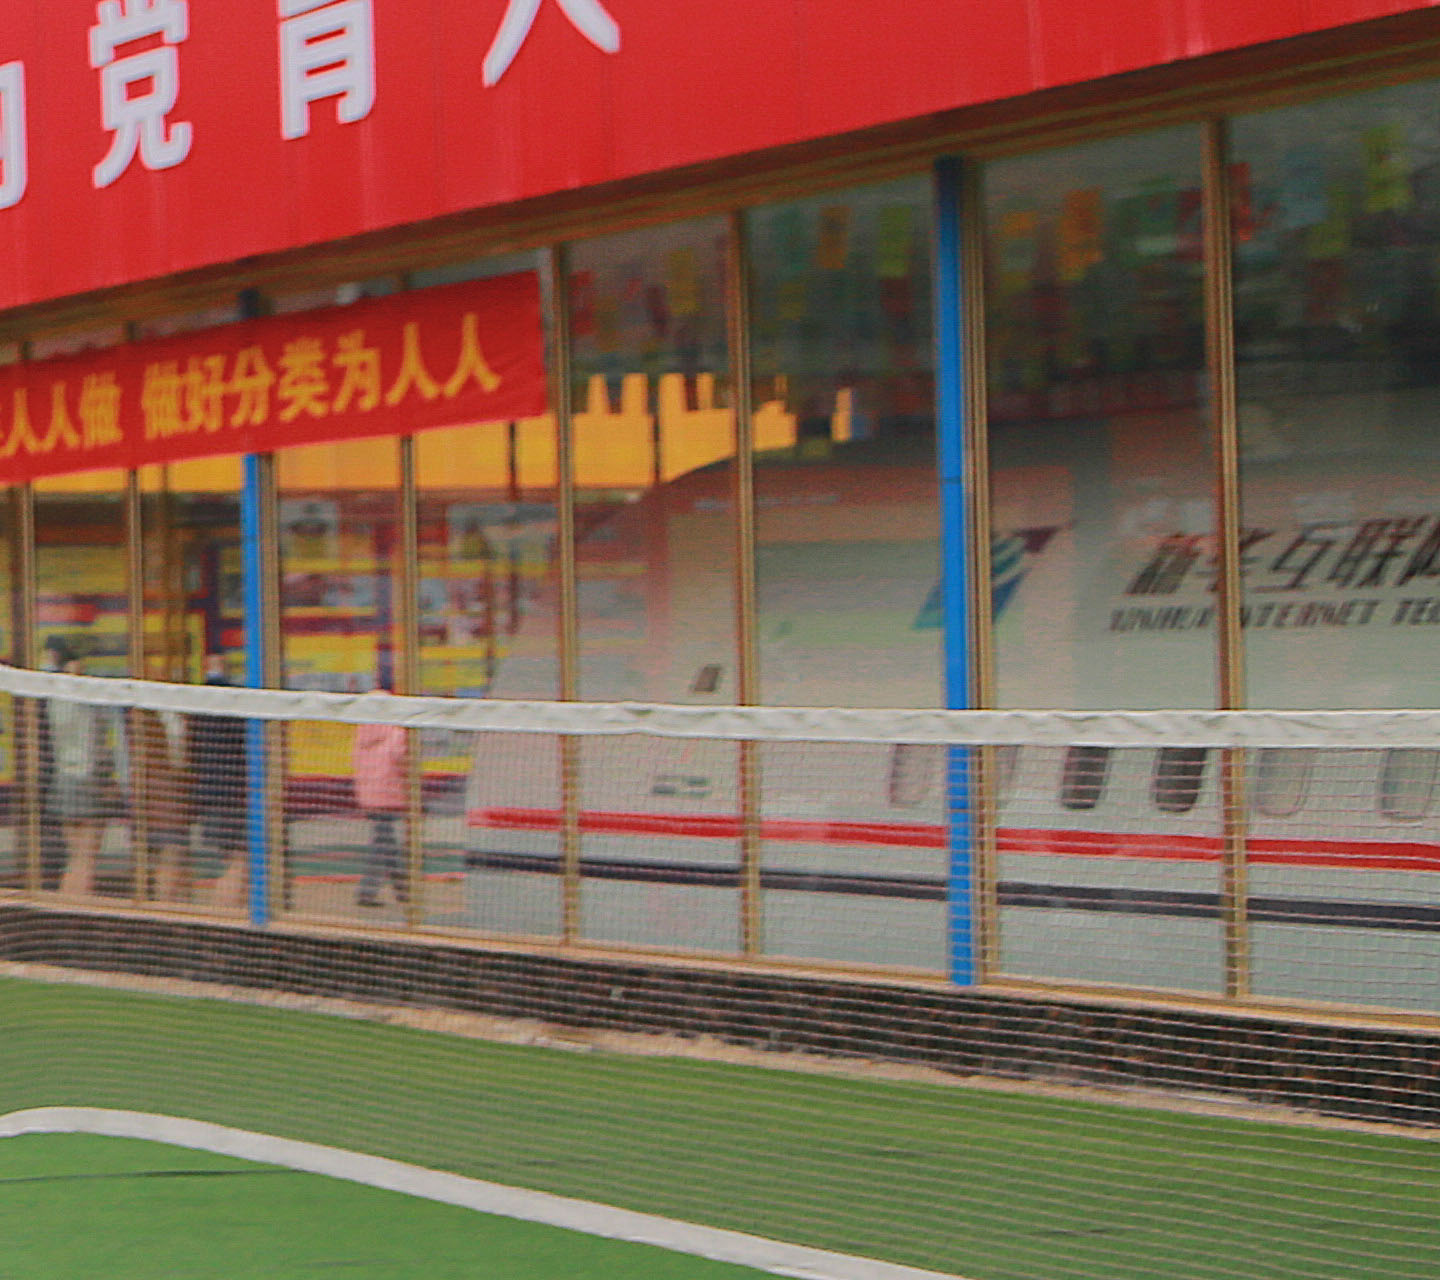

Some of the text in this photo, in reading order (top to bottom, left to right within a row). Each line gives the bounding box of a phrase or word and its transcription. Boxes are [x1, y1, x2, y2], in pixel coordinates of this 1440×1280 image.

[141, 313, 504, 443] 做好分类为人人
